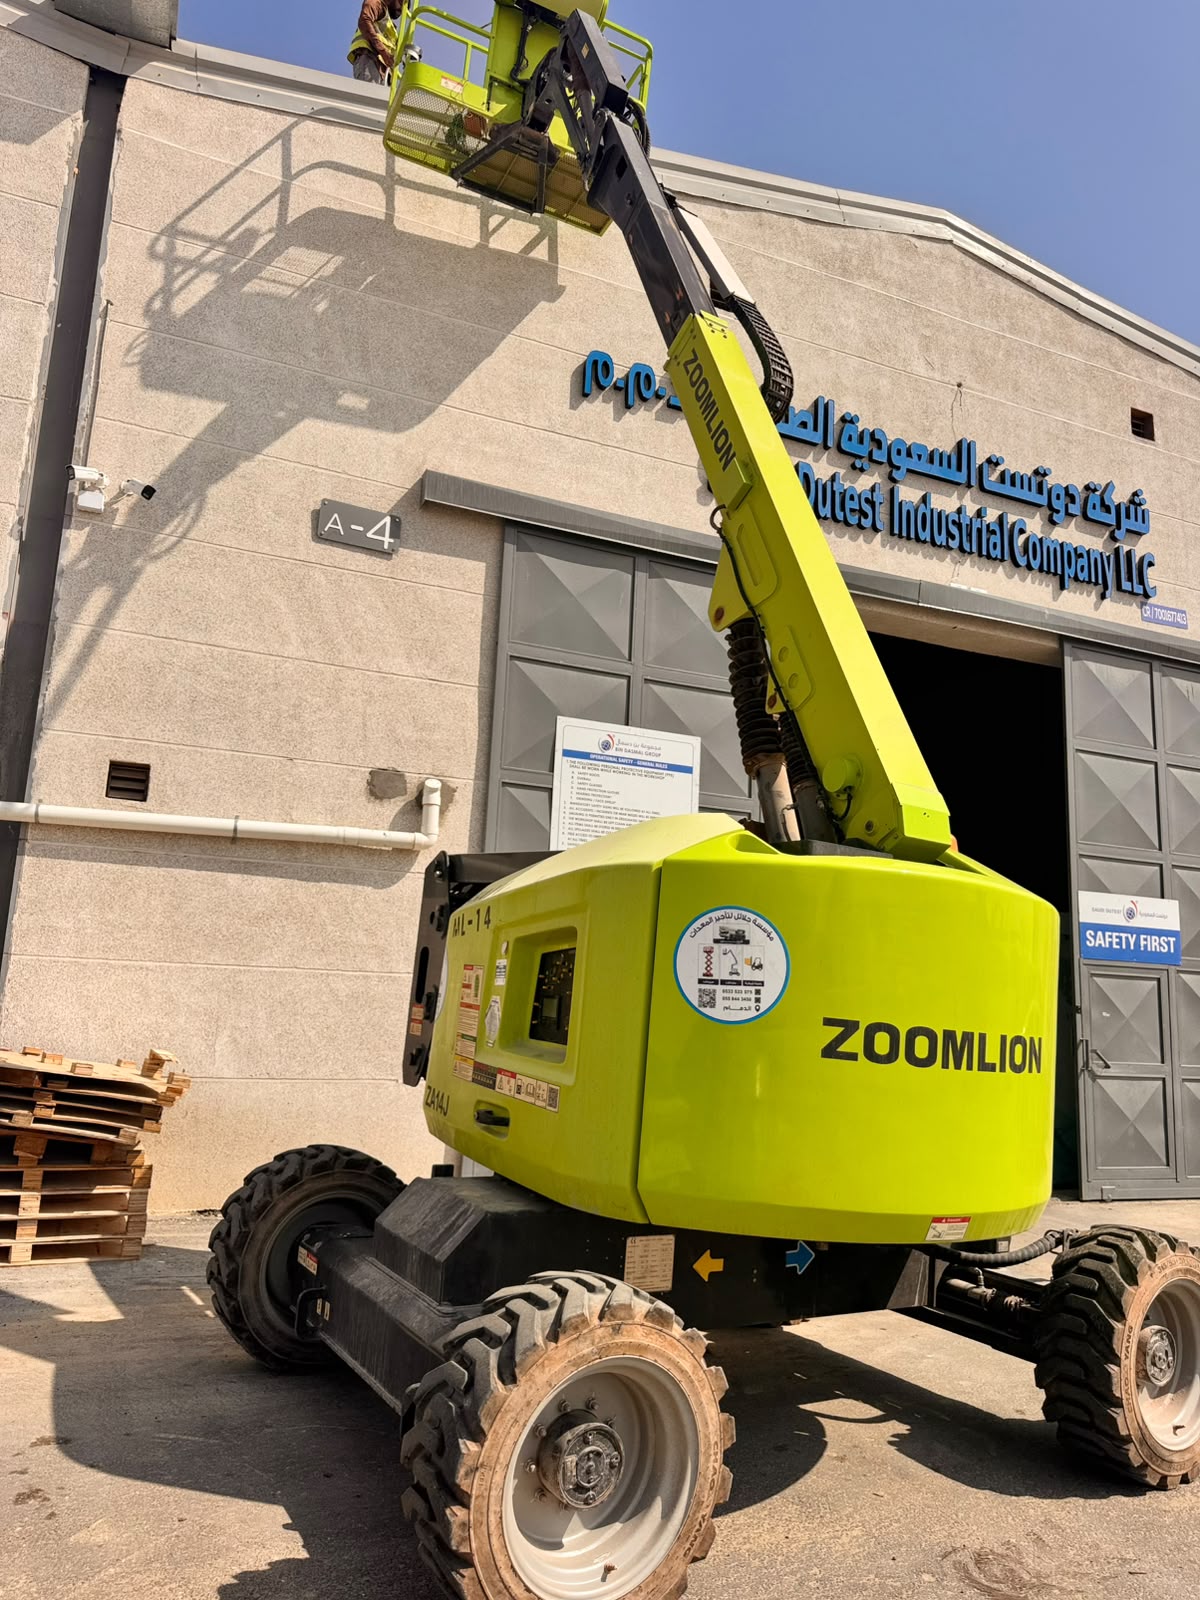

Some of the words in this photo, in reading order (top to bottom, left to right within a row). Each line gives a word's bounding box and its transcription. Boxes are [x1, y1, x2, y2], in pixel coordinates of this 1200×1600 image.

[683, 348, 736, 472] ZOOMLION
[838, 411, 977, 488] السعودية
[979, 454, 1082, 525] دوتست
[1083, 479, 1150, 542] شركة
[795, 461, 884, 533] Dutest
[890, 484, 1009, 562] Industrial
[1009, 518, 1114, 600] Company
[1114, 545, 1158, 599] LLC
[1086, 930, 1136, 950] SAFETY
[1140, 934, 1176, 953] FIRST
[820, 1016, 1042, 1074] ZOOMLION
[425, 1085, 450, 1117] ZA14J
[1123, 1325, 1134, 1361] YANG
[683, 1513, 708, 1557] YANG
